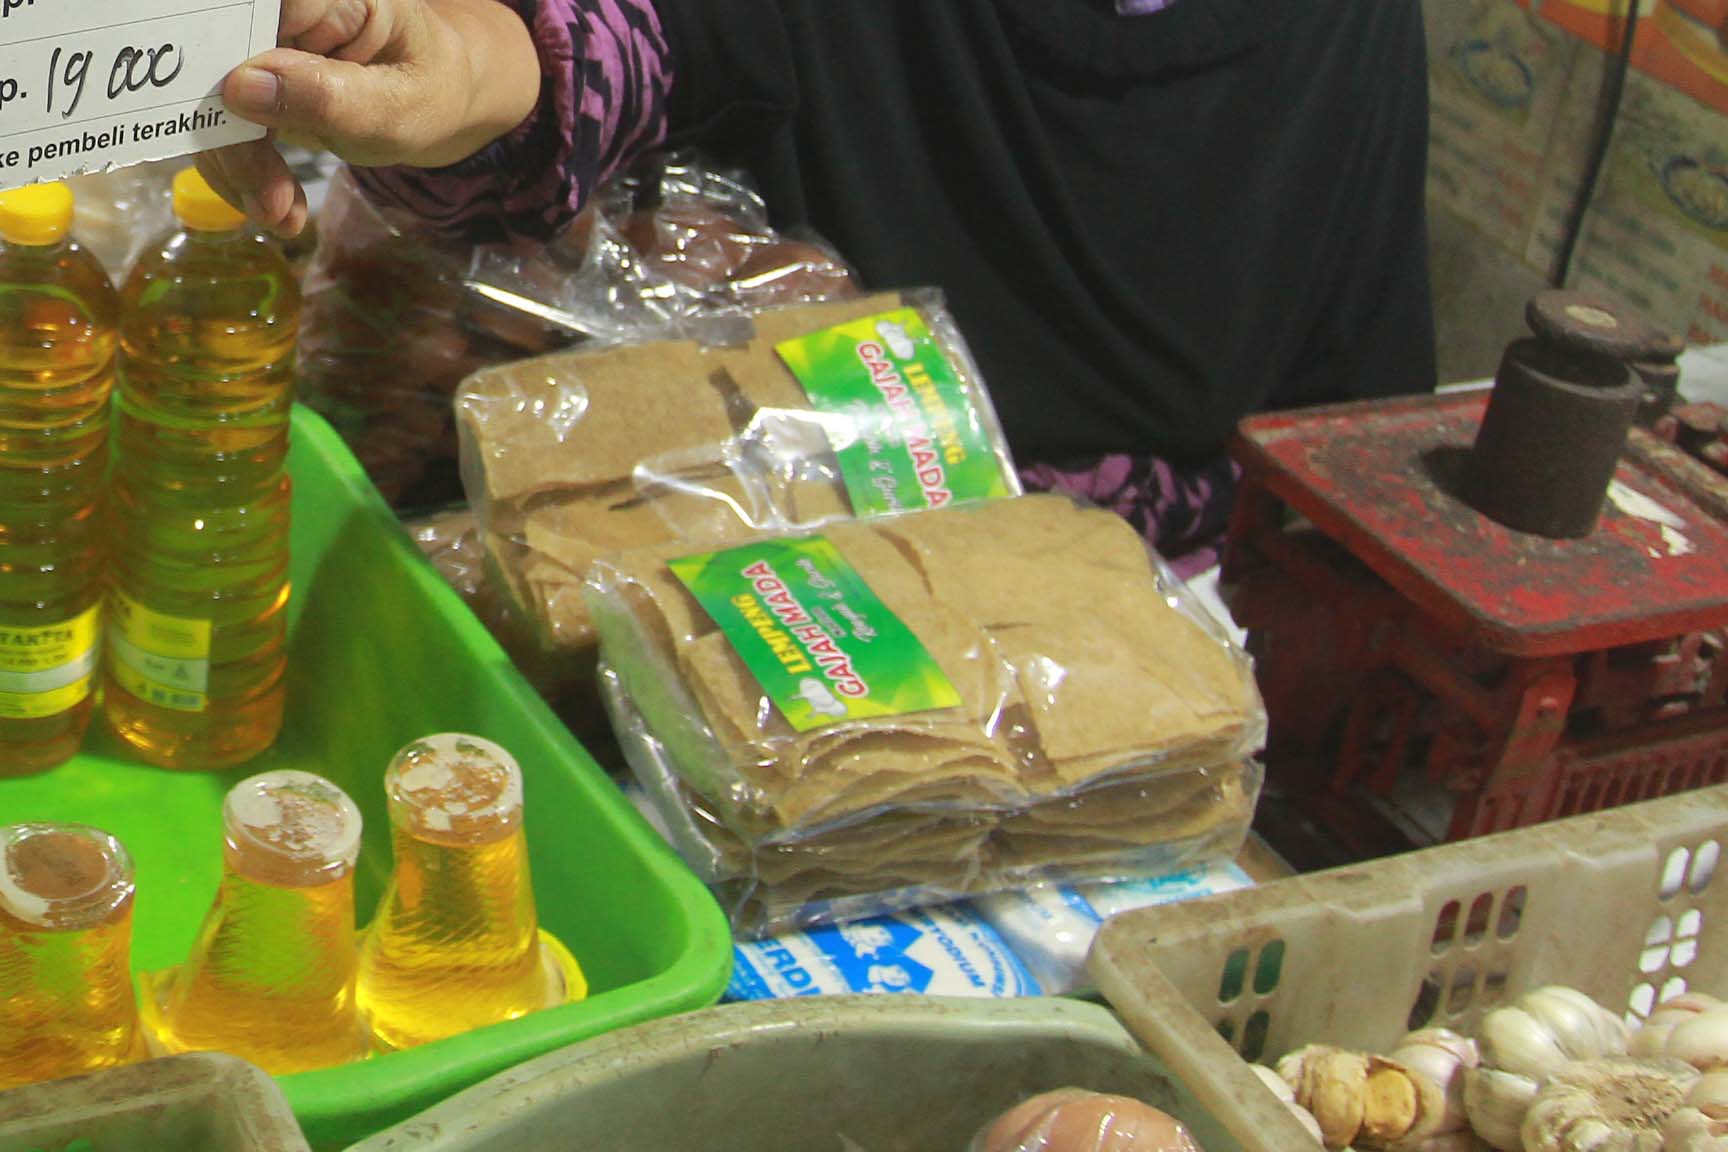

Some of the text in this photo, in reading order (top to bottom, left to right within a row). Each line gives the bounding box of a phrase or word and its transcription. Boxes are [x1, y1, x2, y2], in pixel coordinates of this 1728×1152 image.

[27, 125, 125, 169] pembeli
[132, 107, 227, 143] terakhir.
[742, 559, 812, 627] MADA
[730, 593, 812, 675] LEMPENG
[793, 621, 869, 697] GAJAH
